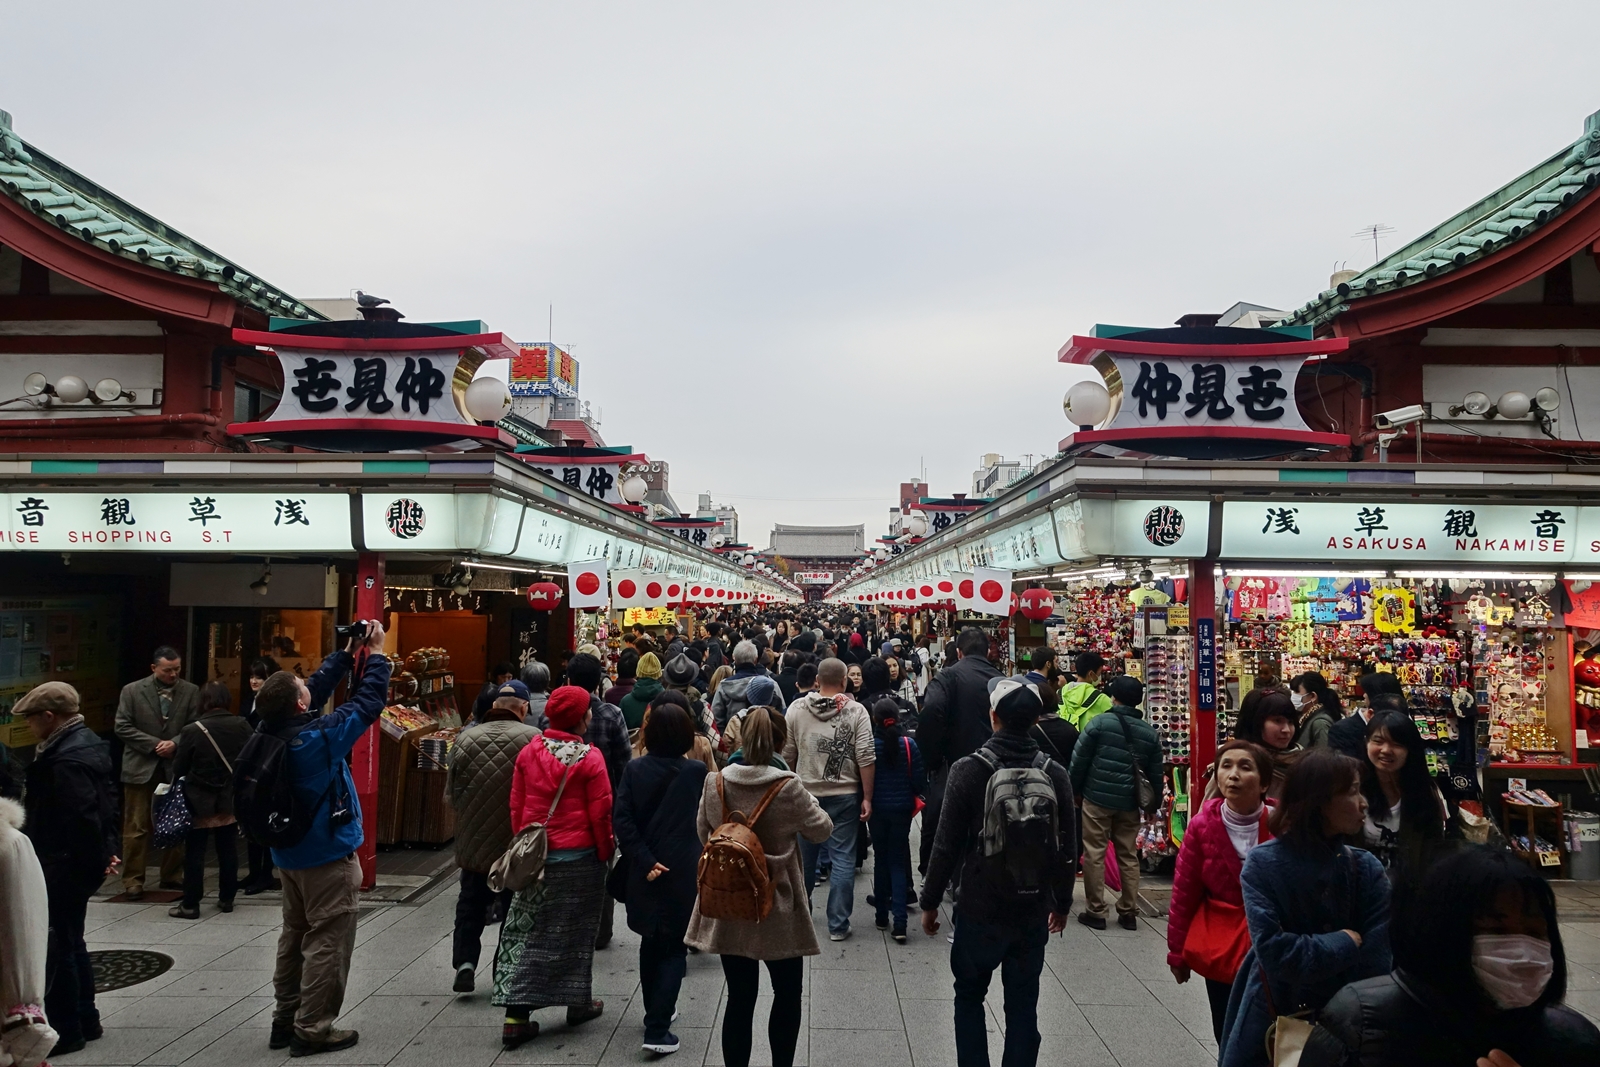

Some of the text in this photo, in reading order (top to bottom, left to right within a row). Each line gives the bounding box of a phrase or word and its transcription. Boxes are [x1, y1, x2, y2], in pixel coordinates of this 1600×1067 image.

[512, 348, 547, 380] 薬
[1132, 361, 1288, 421] 仲見世
[0, 531, 40, 543] ISE
[68, 530, 172, 543] SHOPPING
[1326, 536, 1427, 551] ASAKUSA
[1455, 538, 1565, 552] NAKAMISE
[1202, 638, 1210, 687] 浅草一丁目
[1201, 693, 1212, 703] 18
